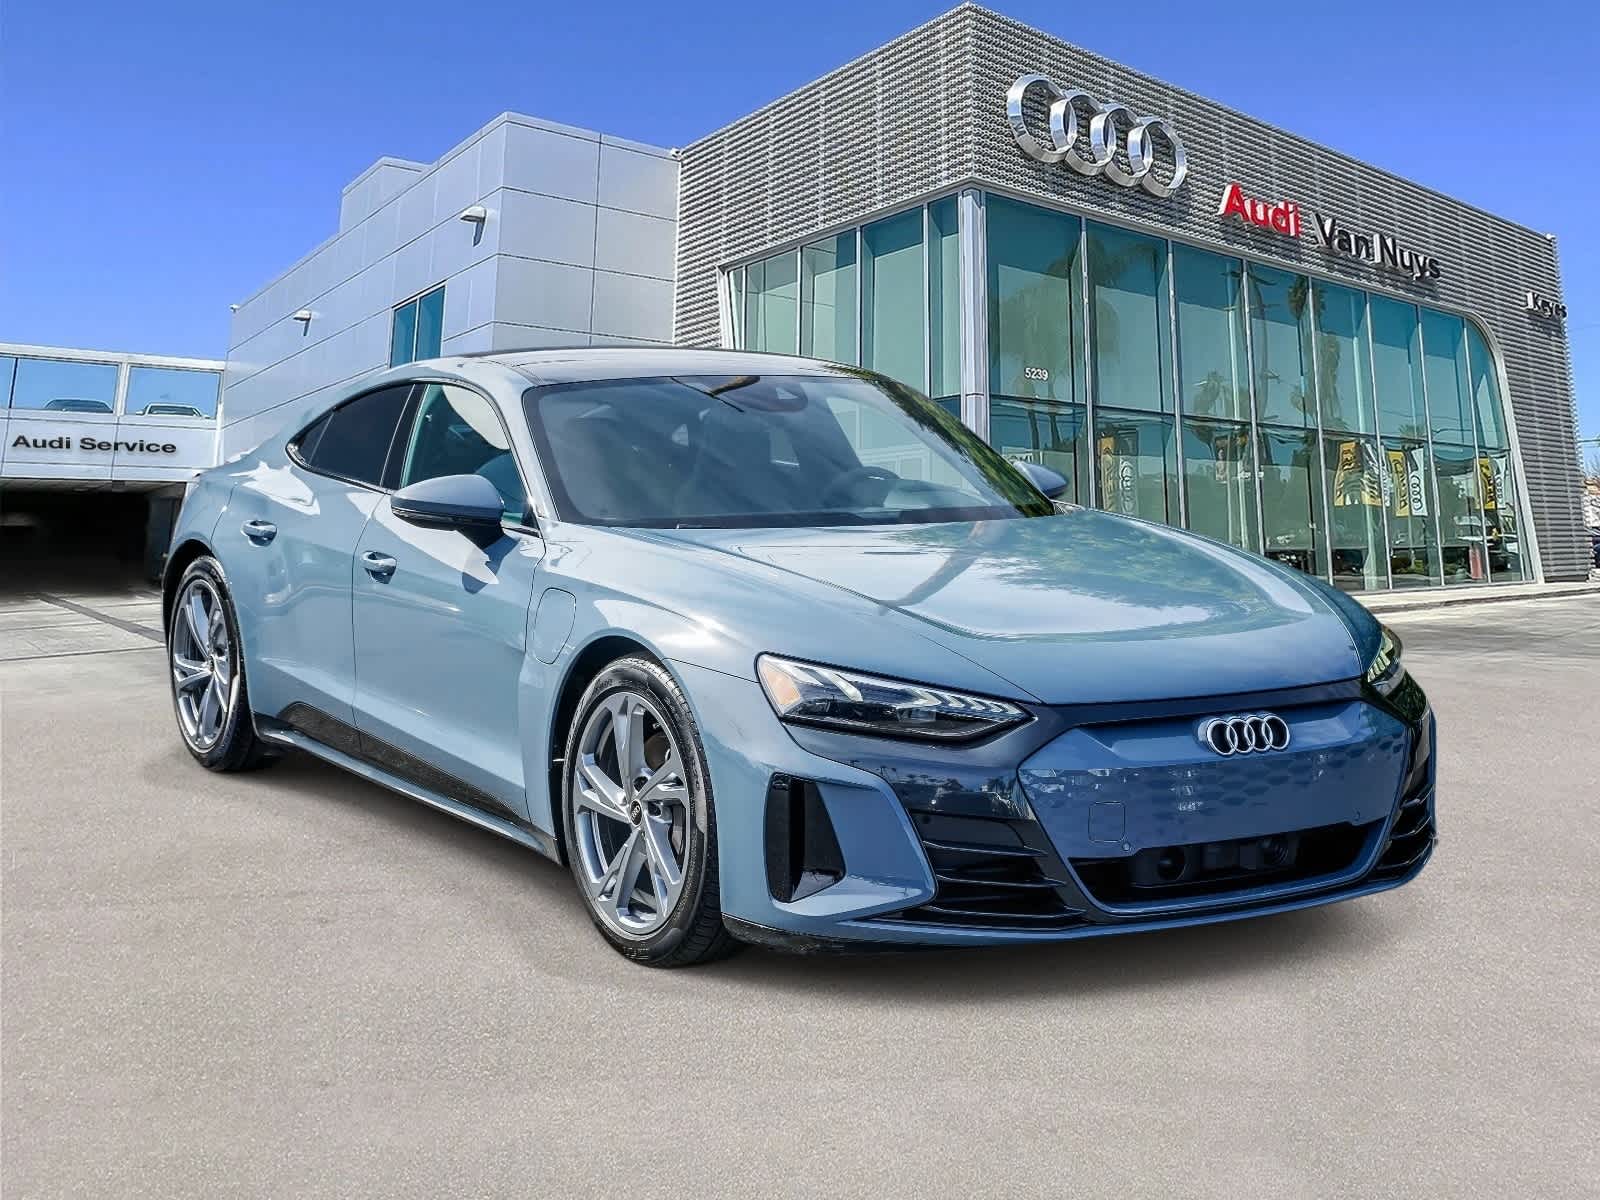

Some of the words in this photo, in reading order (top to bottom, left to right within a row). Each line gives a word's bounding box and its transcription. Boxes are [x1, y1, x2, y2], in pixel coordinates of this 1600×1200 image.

[1218, 183, 1301, 237] Audi
[1312, 212, 1373, 258] Van
[1374, 232, 1441, 281] Nuys
[1526, 292, 1568, 318] Keyes
[1024, 367, 1049, 381] 5239
[12, 435, 71, 450] Audi
[80, 438, 177, 453] Service
